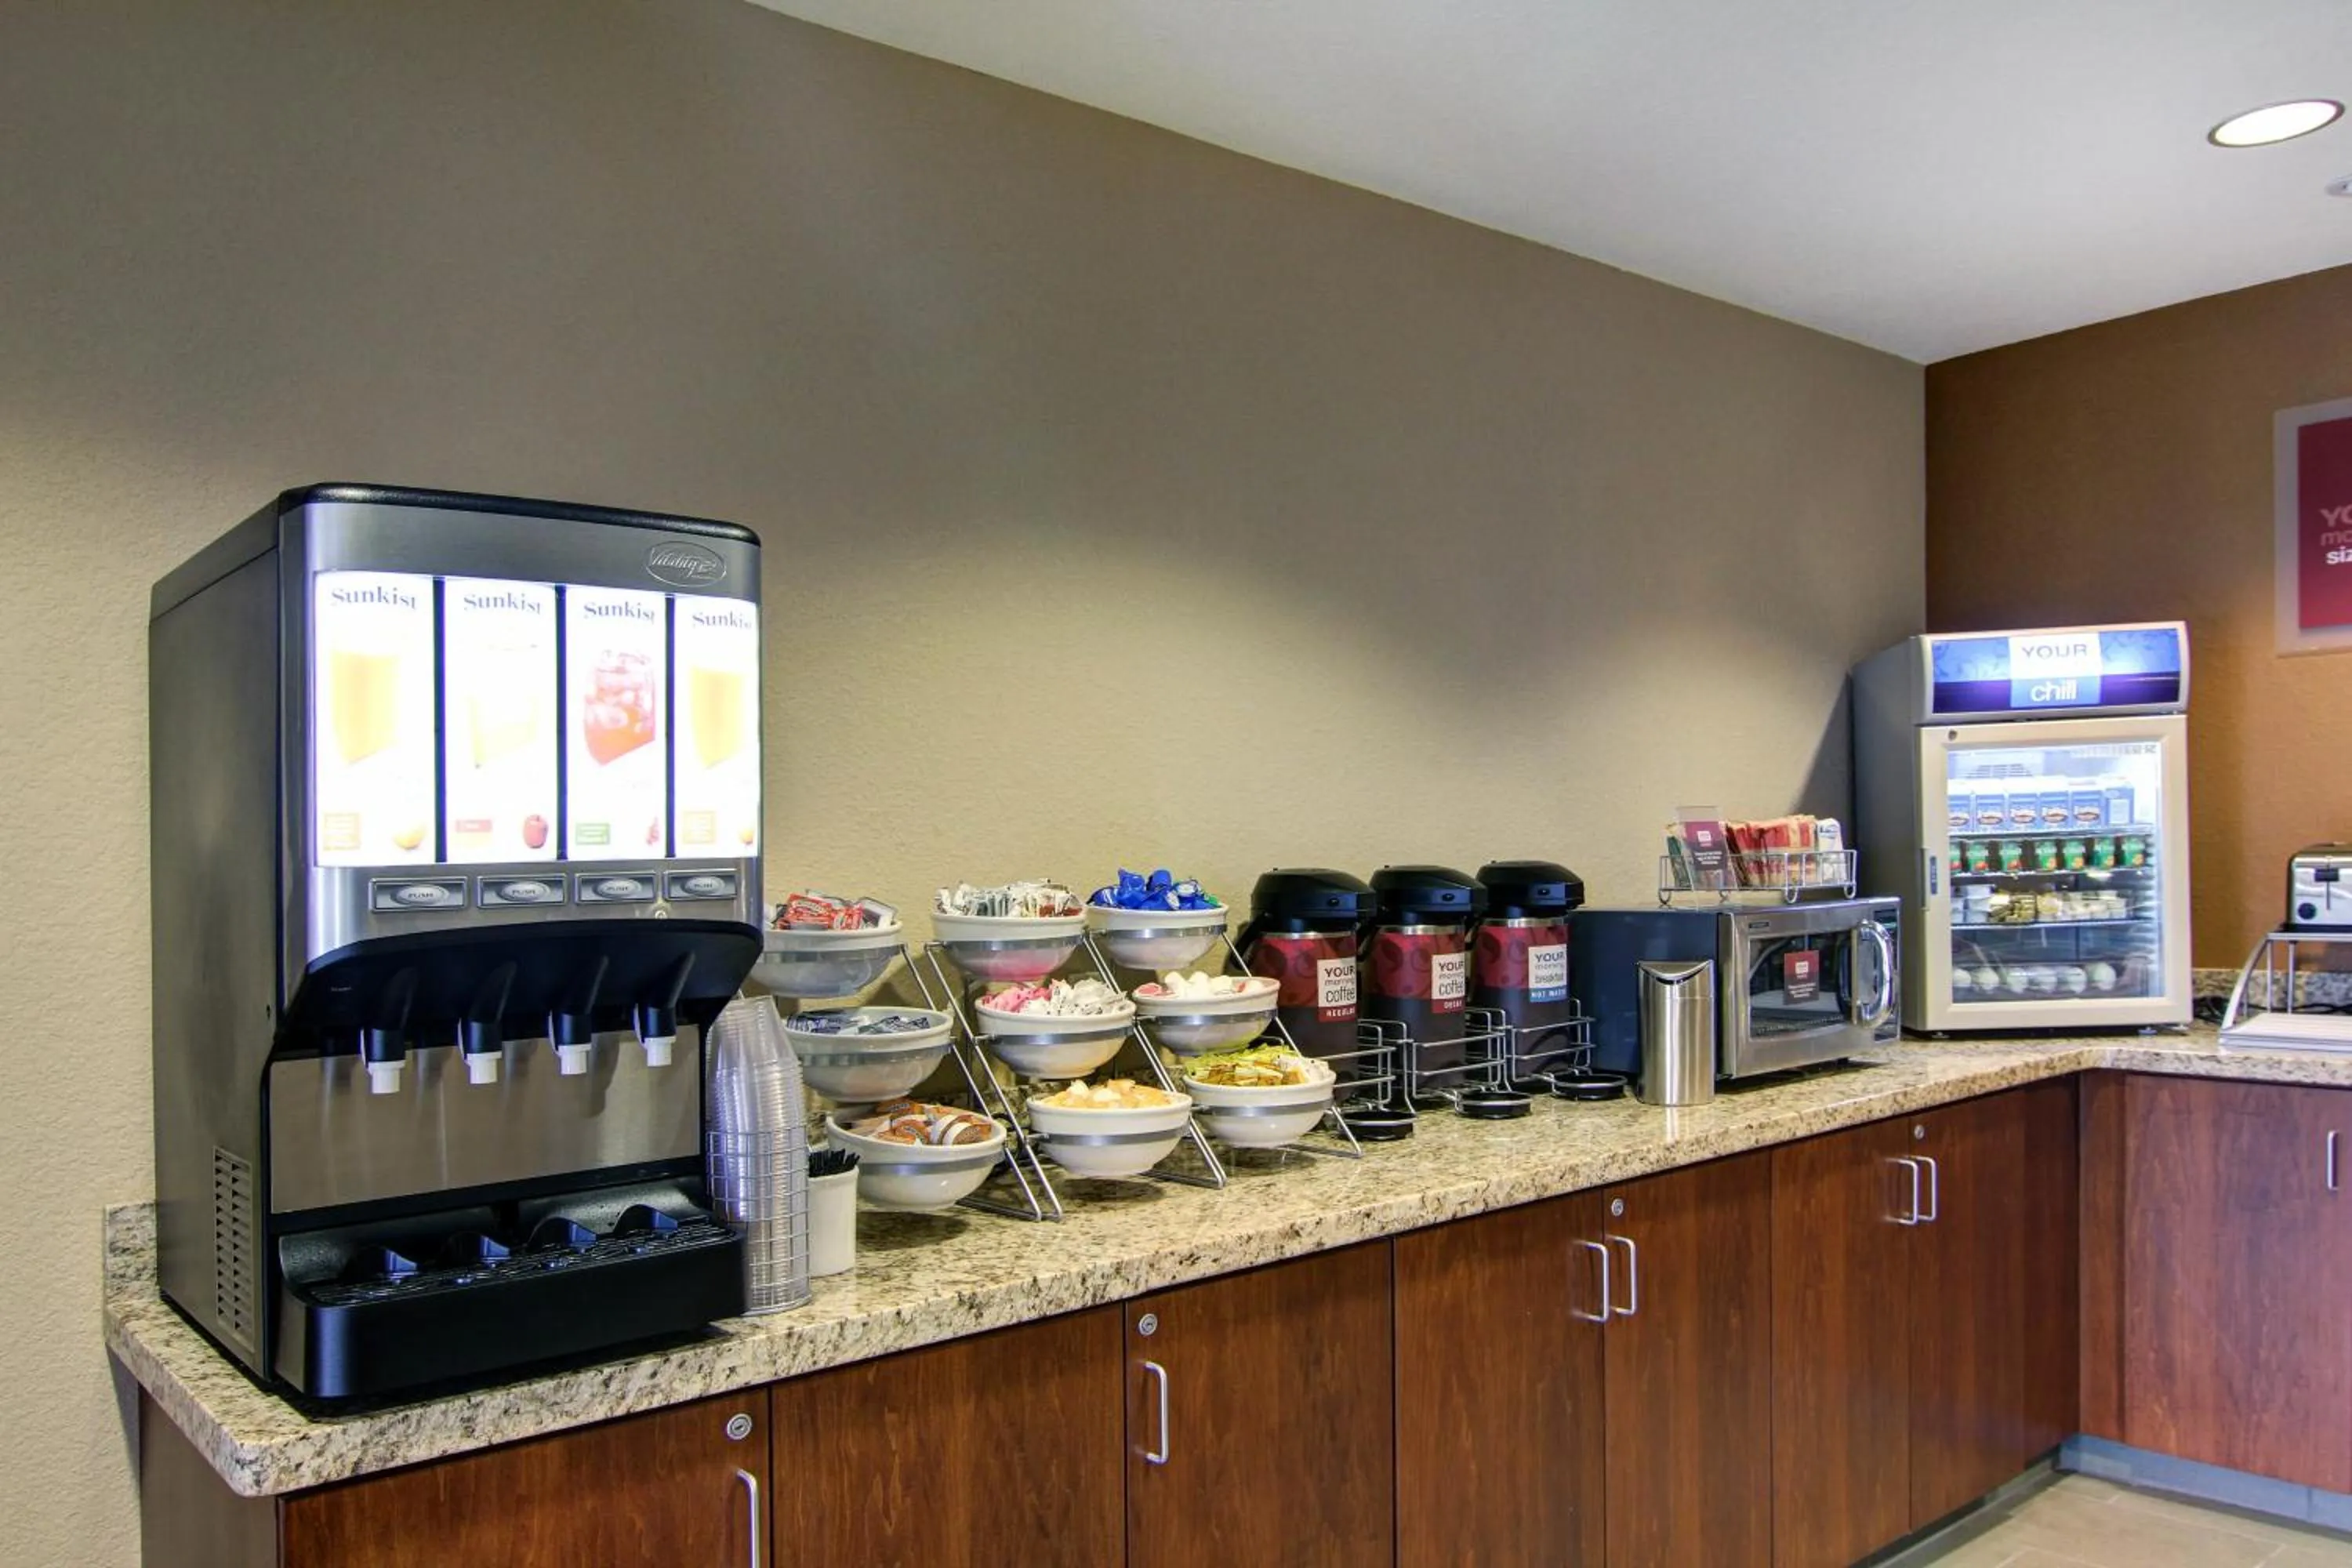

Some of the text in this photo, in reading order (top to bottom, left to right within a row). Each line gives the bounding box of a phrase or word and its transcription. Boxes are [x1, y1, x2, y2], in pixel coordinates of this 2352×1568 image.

[331, 586, 416, 609] Sunkist
[463, 593, 541, 614] Sunkist
[583, 601, 655, 624] Sunkist
[692, 611, 752, 629] Sunkis
[2022, 644, 2087, 659] YOUR
[2031, 679, 2077, 702] chill
[1534, 951, 1565, 962] YOUR
[1324, 965, 1356, 977] YOUR
[1326, 986, 1356, 1003] coffee
